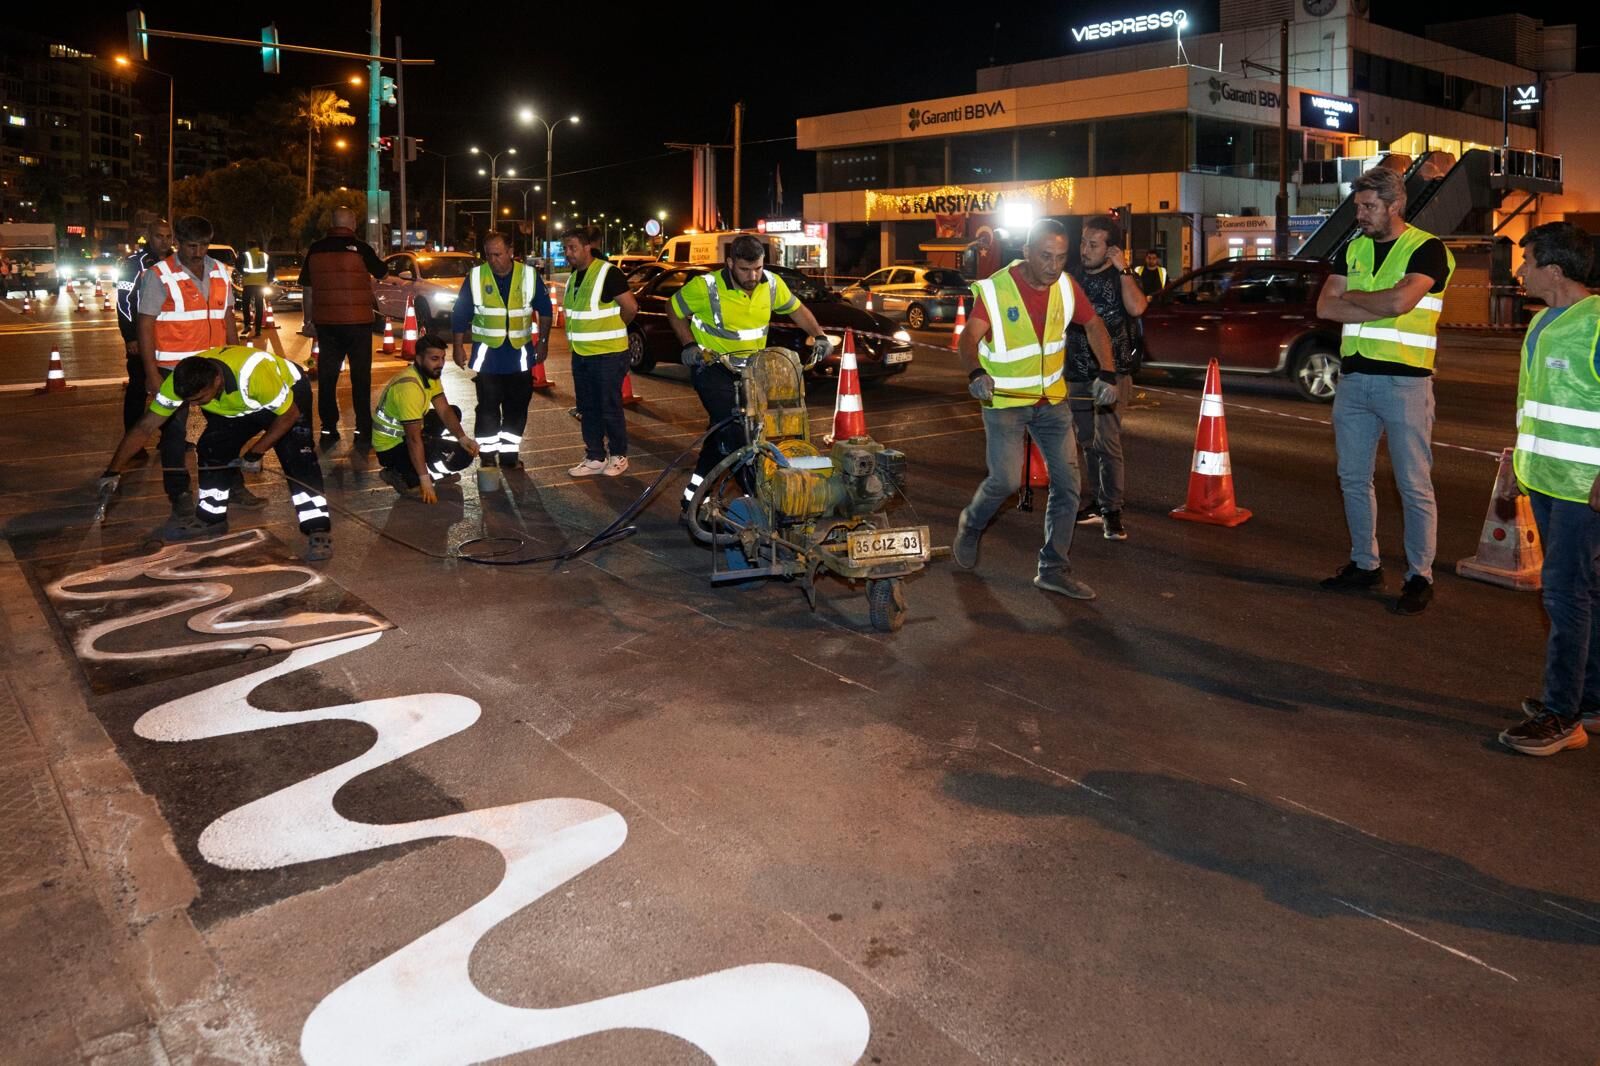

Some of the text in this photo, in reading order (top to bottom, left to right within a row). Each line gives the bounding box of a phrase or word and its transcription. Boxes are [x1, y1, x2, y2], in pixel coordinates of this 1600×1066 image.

[1072, 9, 1187, 42] VIESPRESSO
[1221, 82, 1257, 105] Garanti
[921, 99, 1006, 125] Garanti BBVA
[1246, 219, 1268, 228] BBVA
[856, 536, 918, 553] 35 CIZ 03
